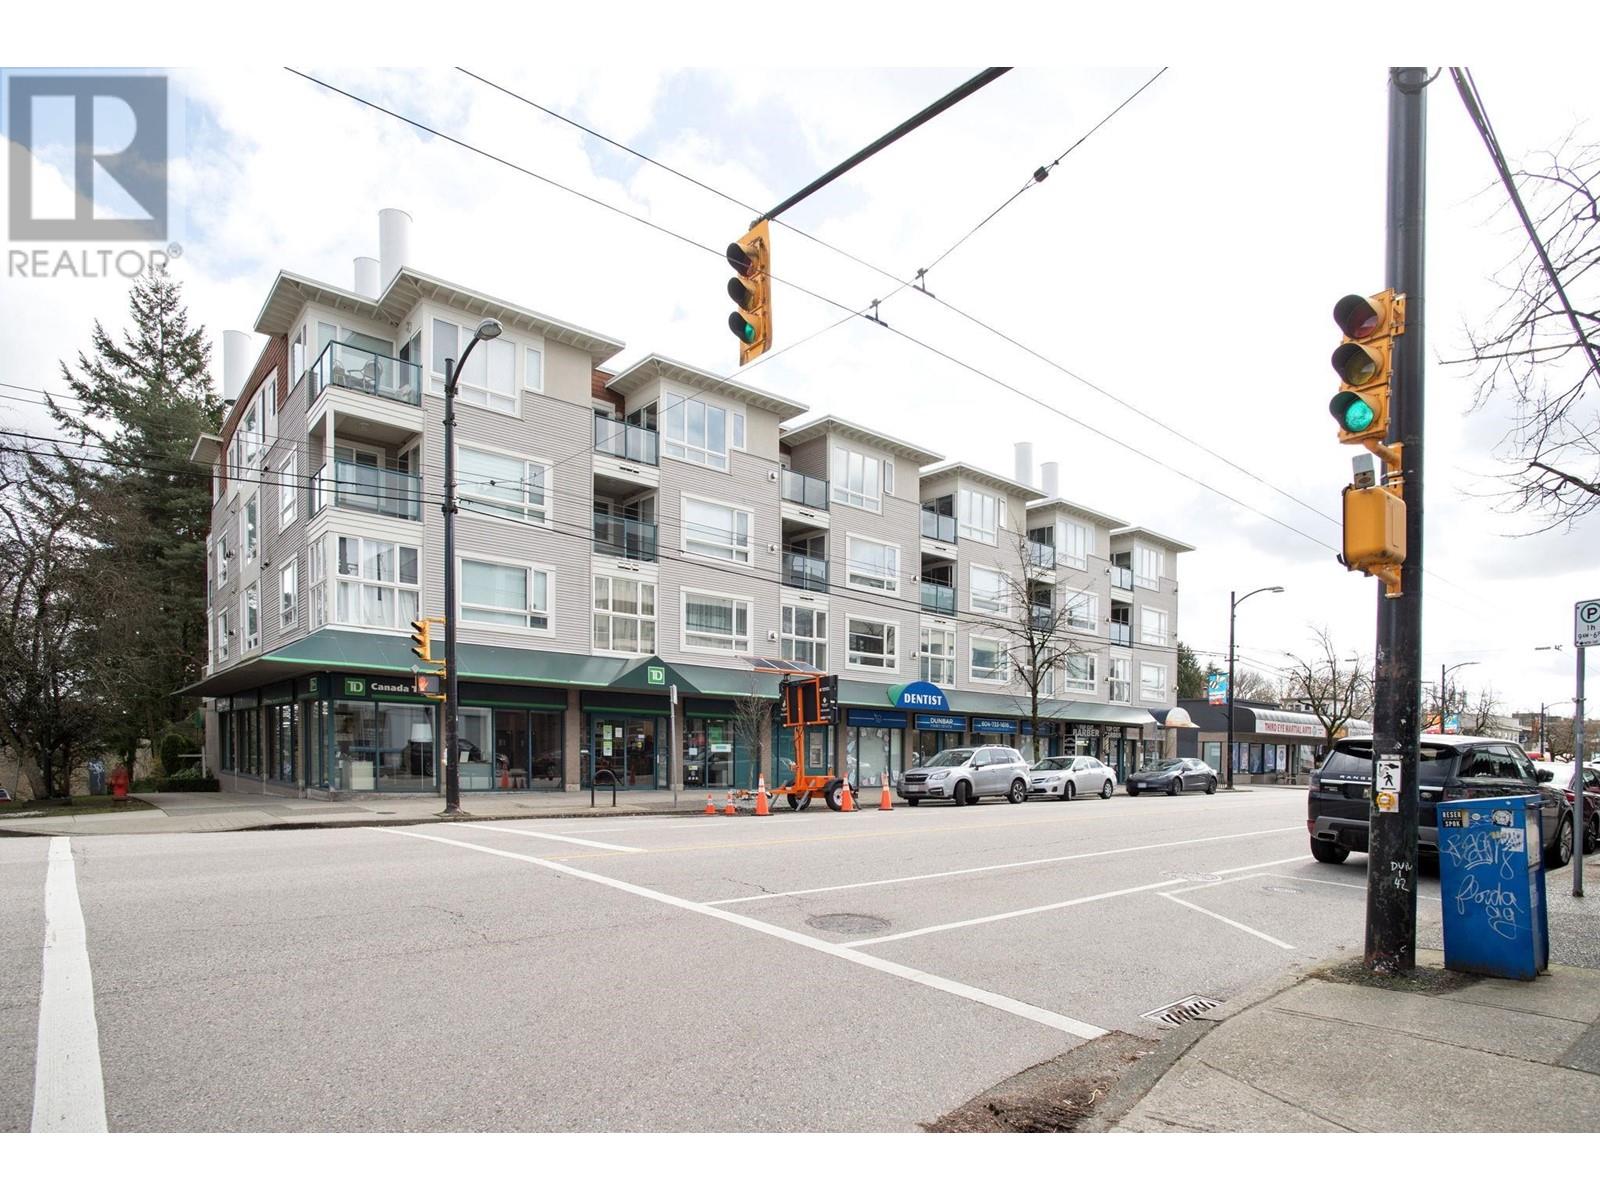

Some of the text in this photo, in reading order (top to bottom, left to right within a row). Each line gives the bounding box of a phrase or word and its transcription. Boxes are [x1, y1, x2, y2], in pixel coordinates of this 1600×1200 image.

[1587, 607, 1598, 619] P
[650, 669, 663, 681] TD
[346, 680, 364, 693] TD
[370, 682, 409, 693] Canada
[904, 693, 943, 706] DENTIST
[929, 717, 954, 725] DUNBAR
[1072, 728, 1100, 737] BARBER
